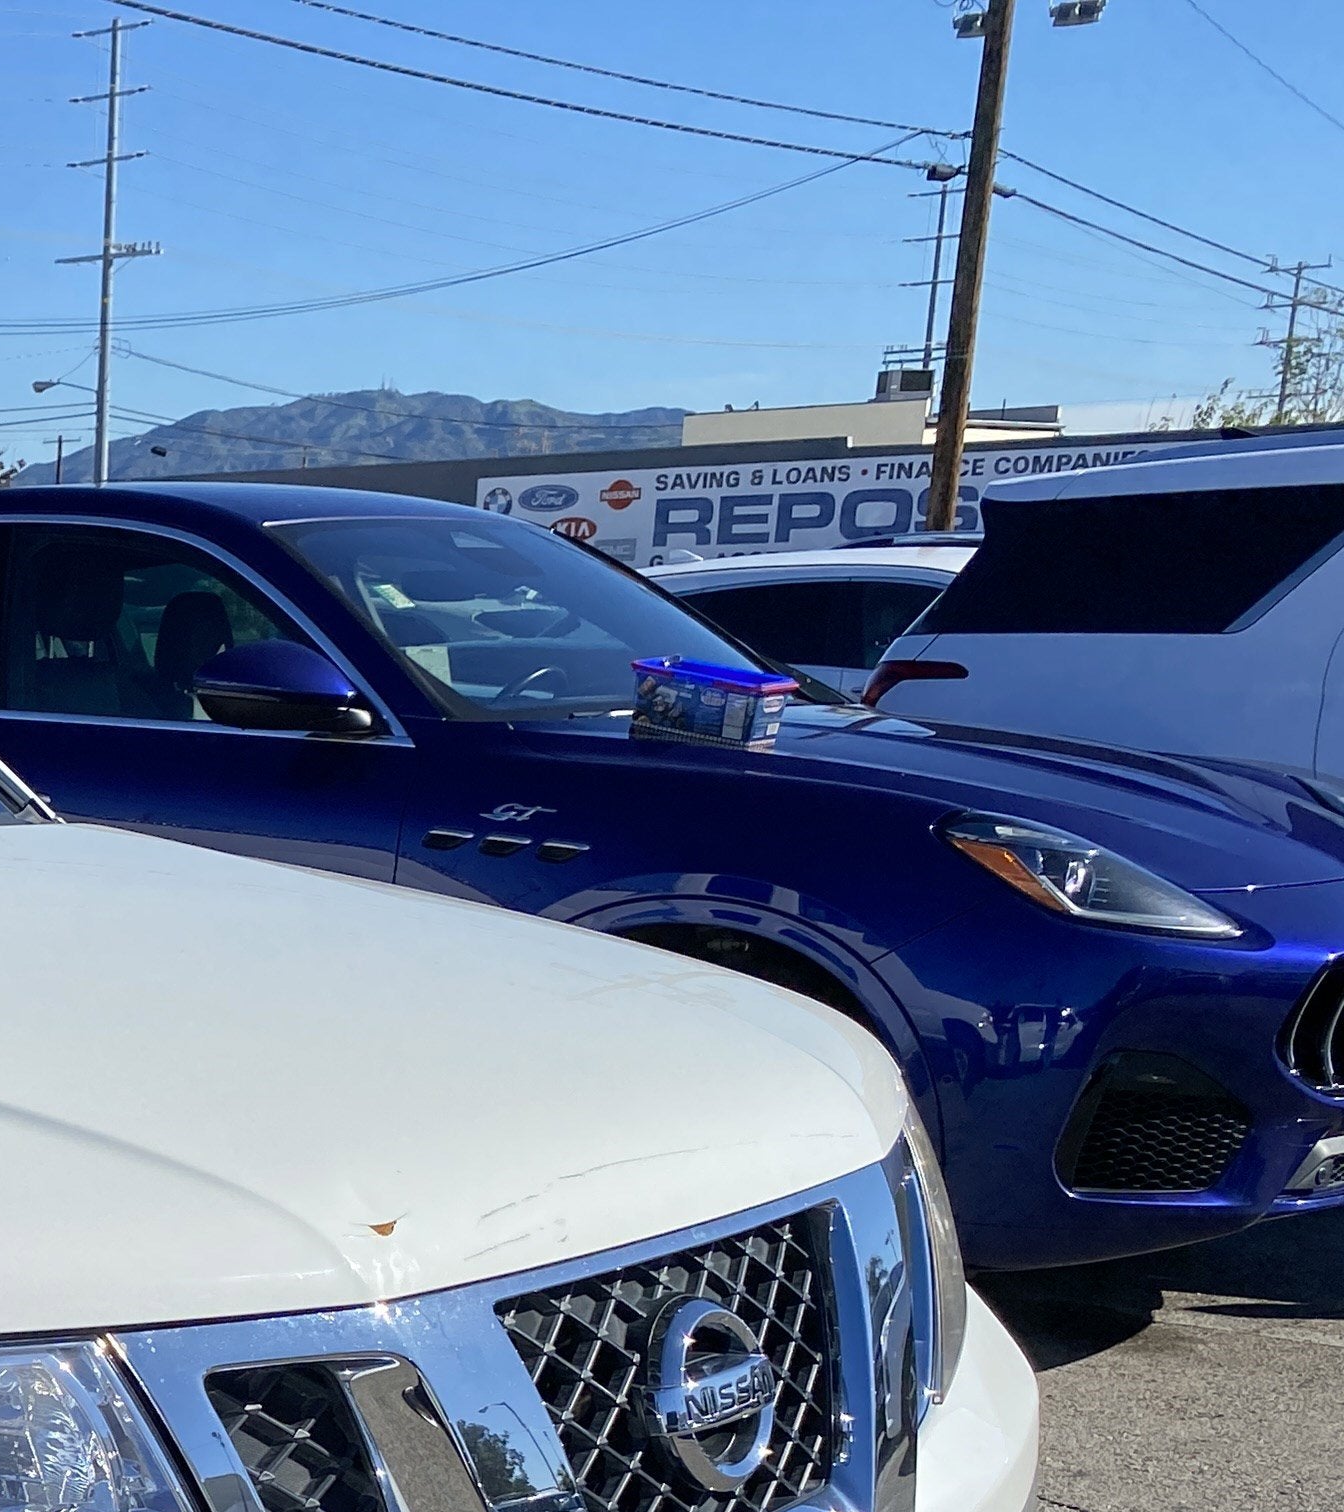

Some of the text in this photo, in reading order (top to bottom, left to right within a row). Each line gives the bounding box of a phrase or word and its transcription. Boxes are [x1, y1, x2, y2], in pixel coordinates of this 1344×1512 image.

[655, 450, 1150, 491] SAVING & LOANS FINACE COMPANI
[531, 490, 566, 507] Ford
[602, 489, 640, 500] NISSAN
[557, 521, 590, 540] KIA
[479, 803, 558, 821] GT
[685, 1363, 776, 1419] NISSAN
